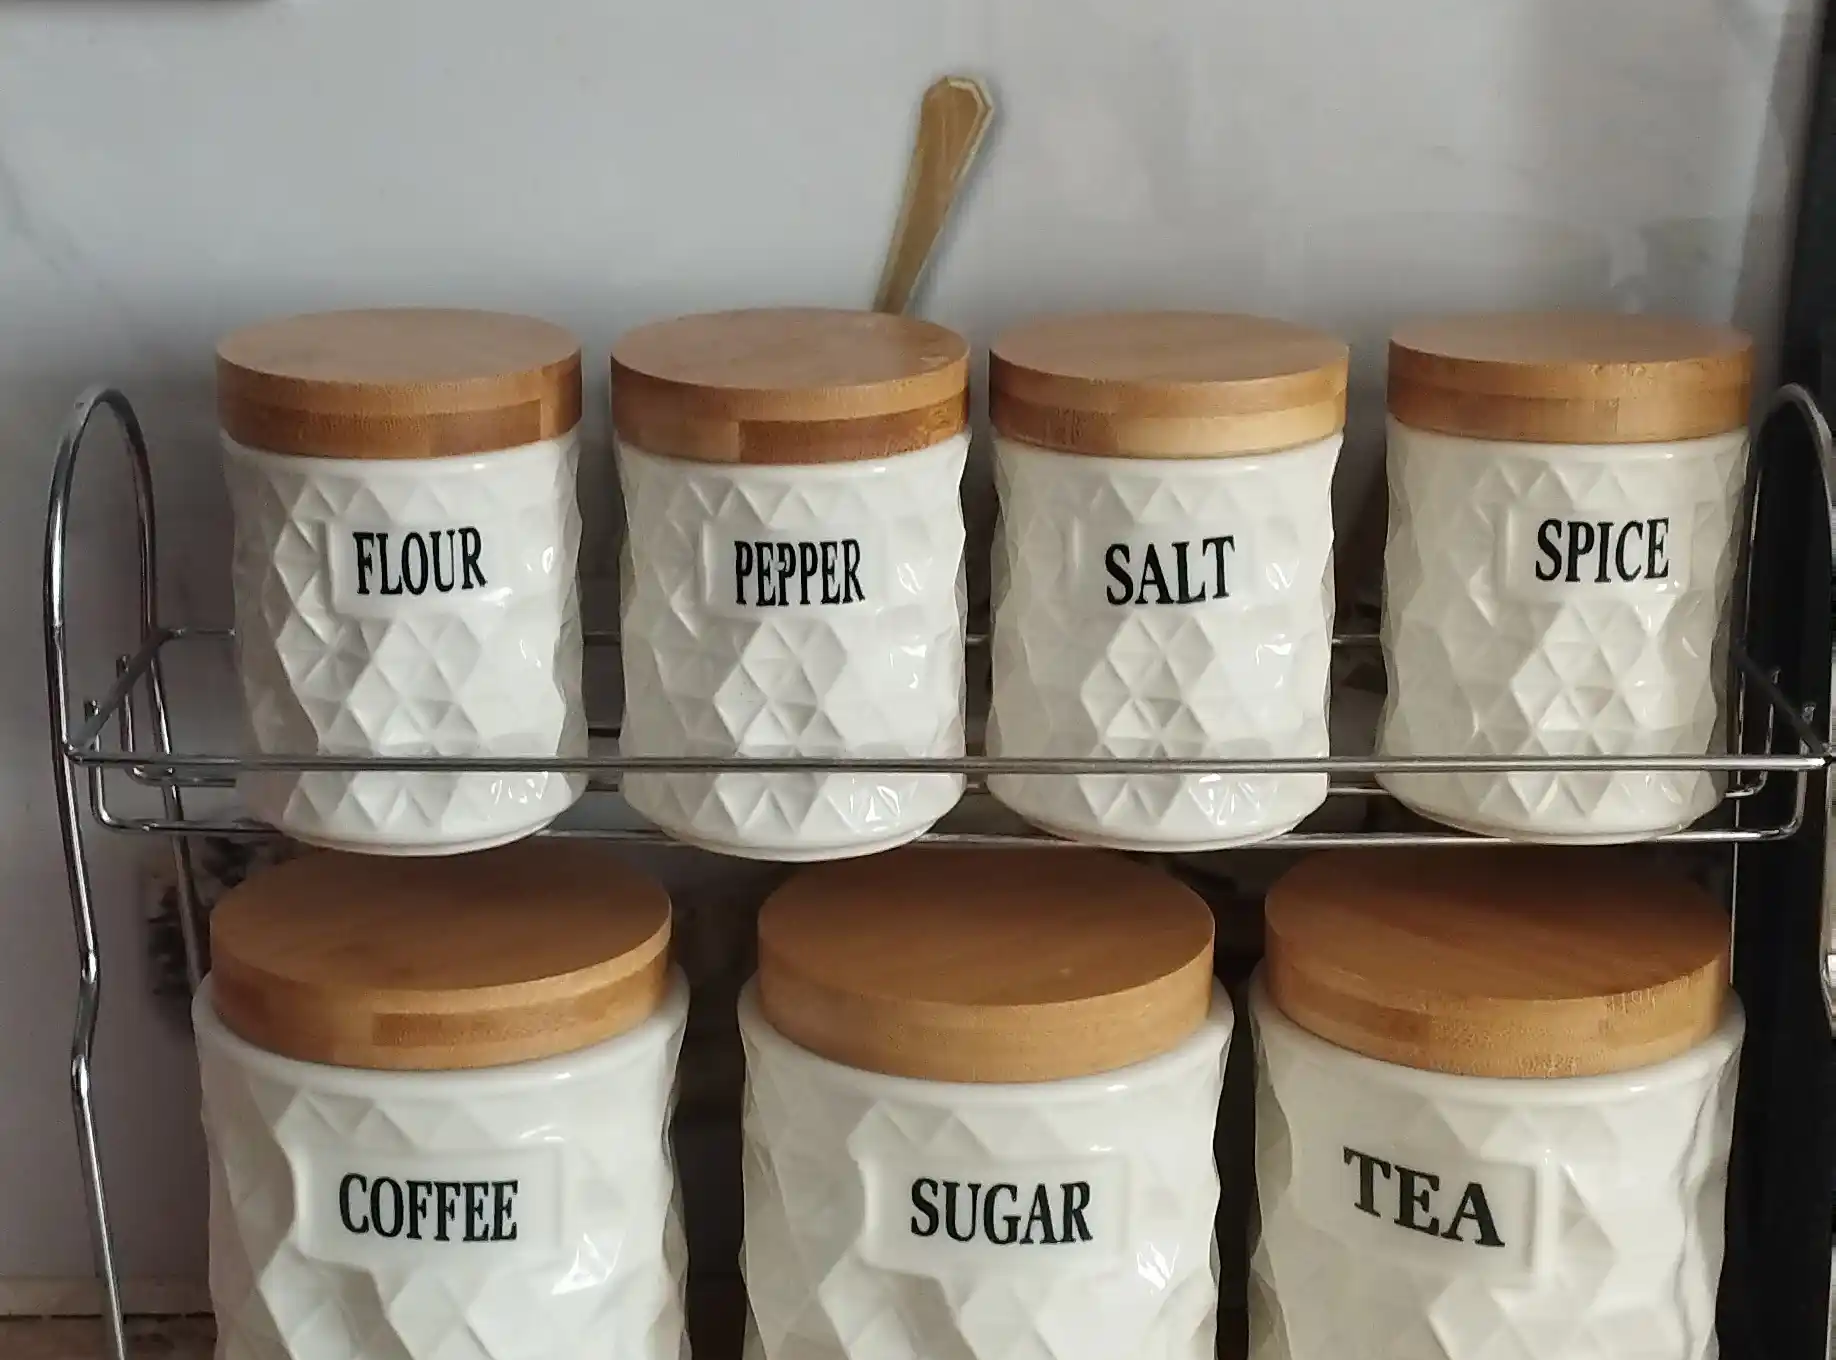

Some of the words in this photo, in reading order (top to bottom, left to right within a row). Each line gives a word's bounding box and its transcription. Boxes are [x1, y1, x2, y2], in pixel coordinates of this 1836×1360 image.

[352, 527, 487, 596] FLOUR
[733, 539, 866, 607] PEPPER
[1104, 535, 1235, 606] SALT
[1535, 518, 1669, 583] SPICE
[338, 1172, 519, 1242] COFFEE
[910, 1177, 1093, 1245] SUGAR
[1343, 1146, 1506, 1248] TEA
